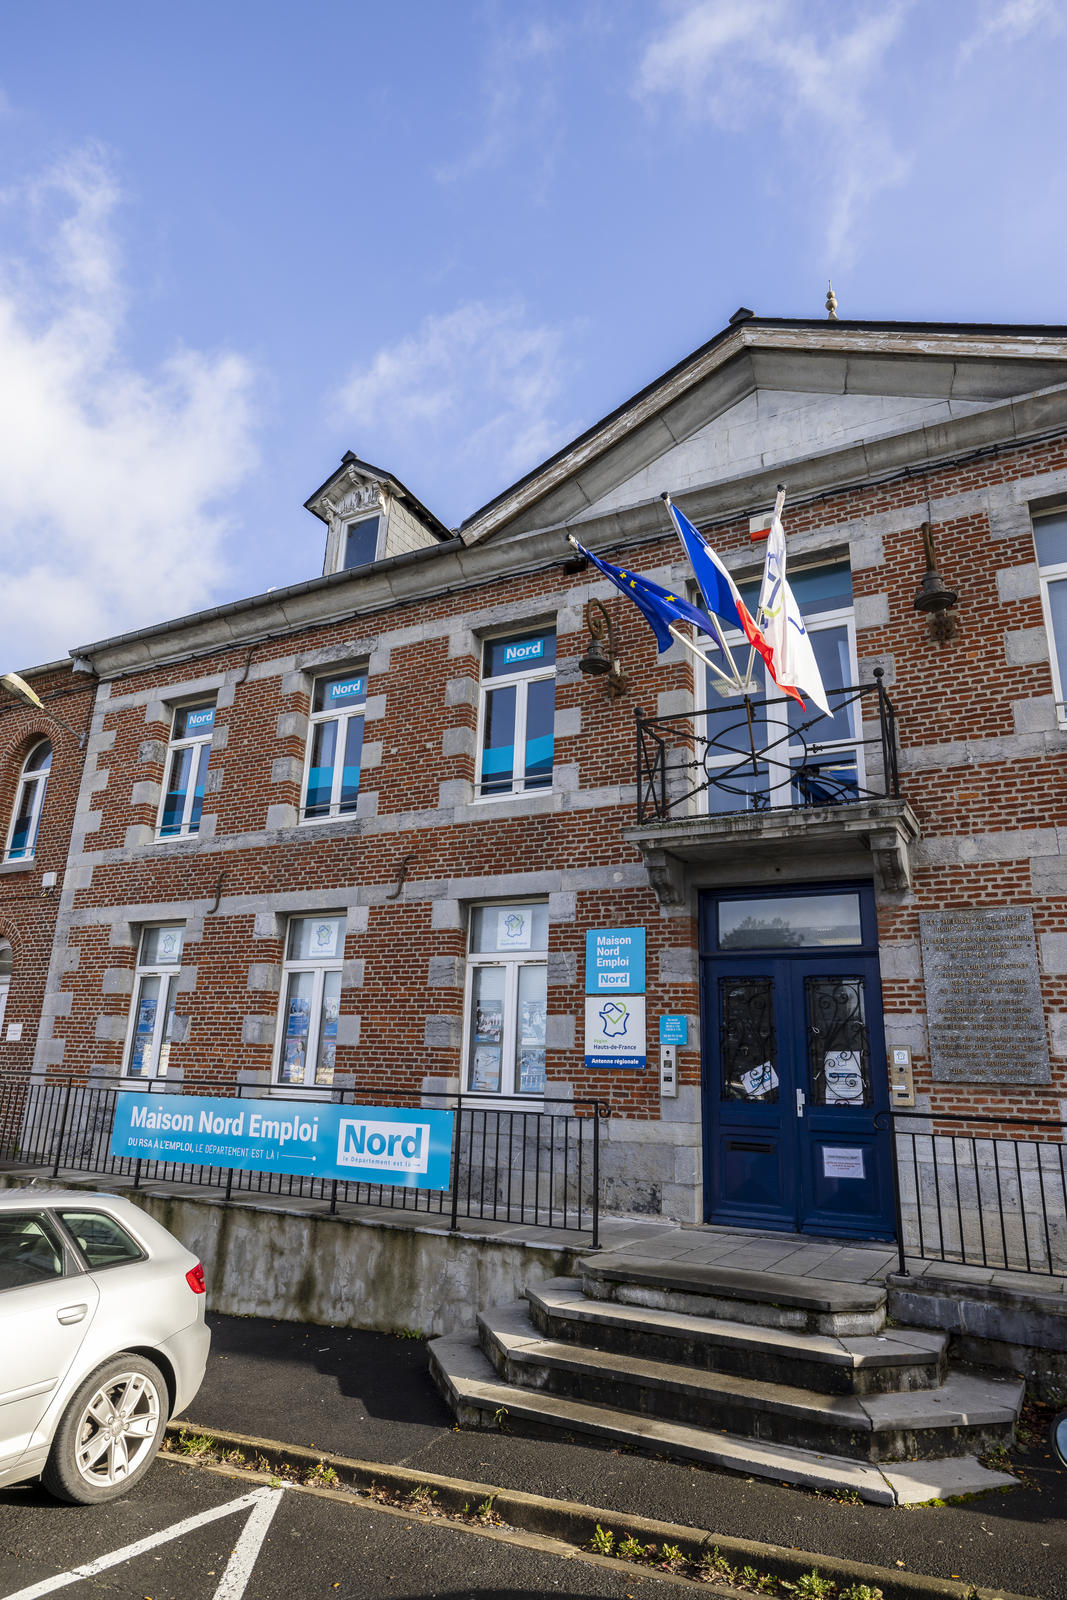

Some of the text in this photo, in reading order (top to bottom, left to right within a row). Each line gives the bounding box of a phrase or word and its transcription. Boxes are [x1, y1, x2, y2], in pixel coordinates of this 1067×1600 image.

[506, 641, 541, 658] Nord
[332, 679, 361, 695] Nord
[189, 711, 213, 725] Nord
[597, 935, 632, 946] Maison
[596, 946, 620, 956] Nord
[596, 956, 629, 968] Emploi
[600, 973, 627, 983] Nord
[614, 1058, 639, 1066] régionale
[130, 1105, 319, 1146] Maison Nord Emploi
[128, 1137, 138, 1146] DU
[138, 1138, 153, 1148] RSA
[195, 1144, 204, 1153] LE
[252, 1148, 264, 1159] EST
[344, 1124, 422, 1159] Nord
